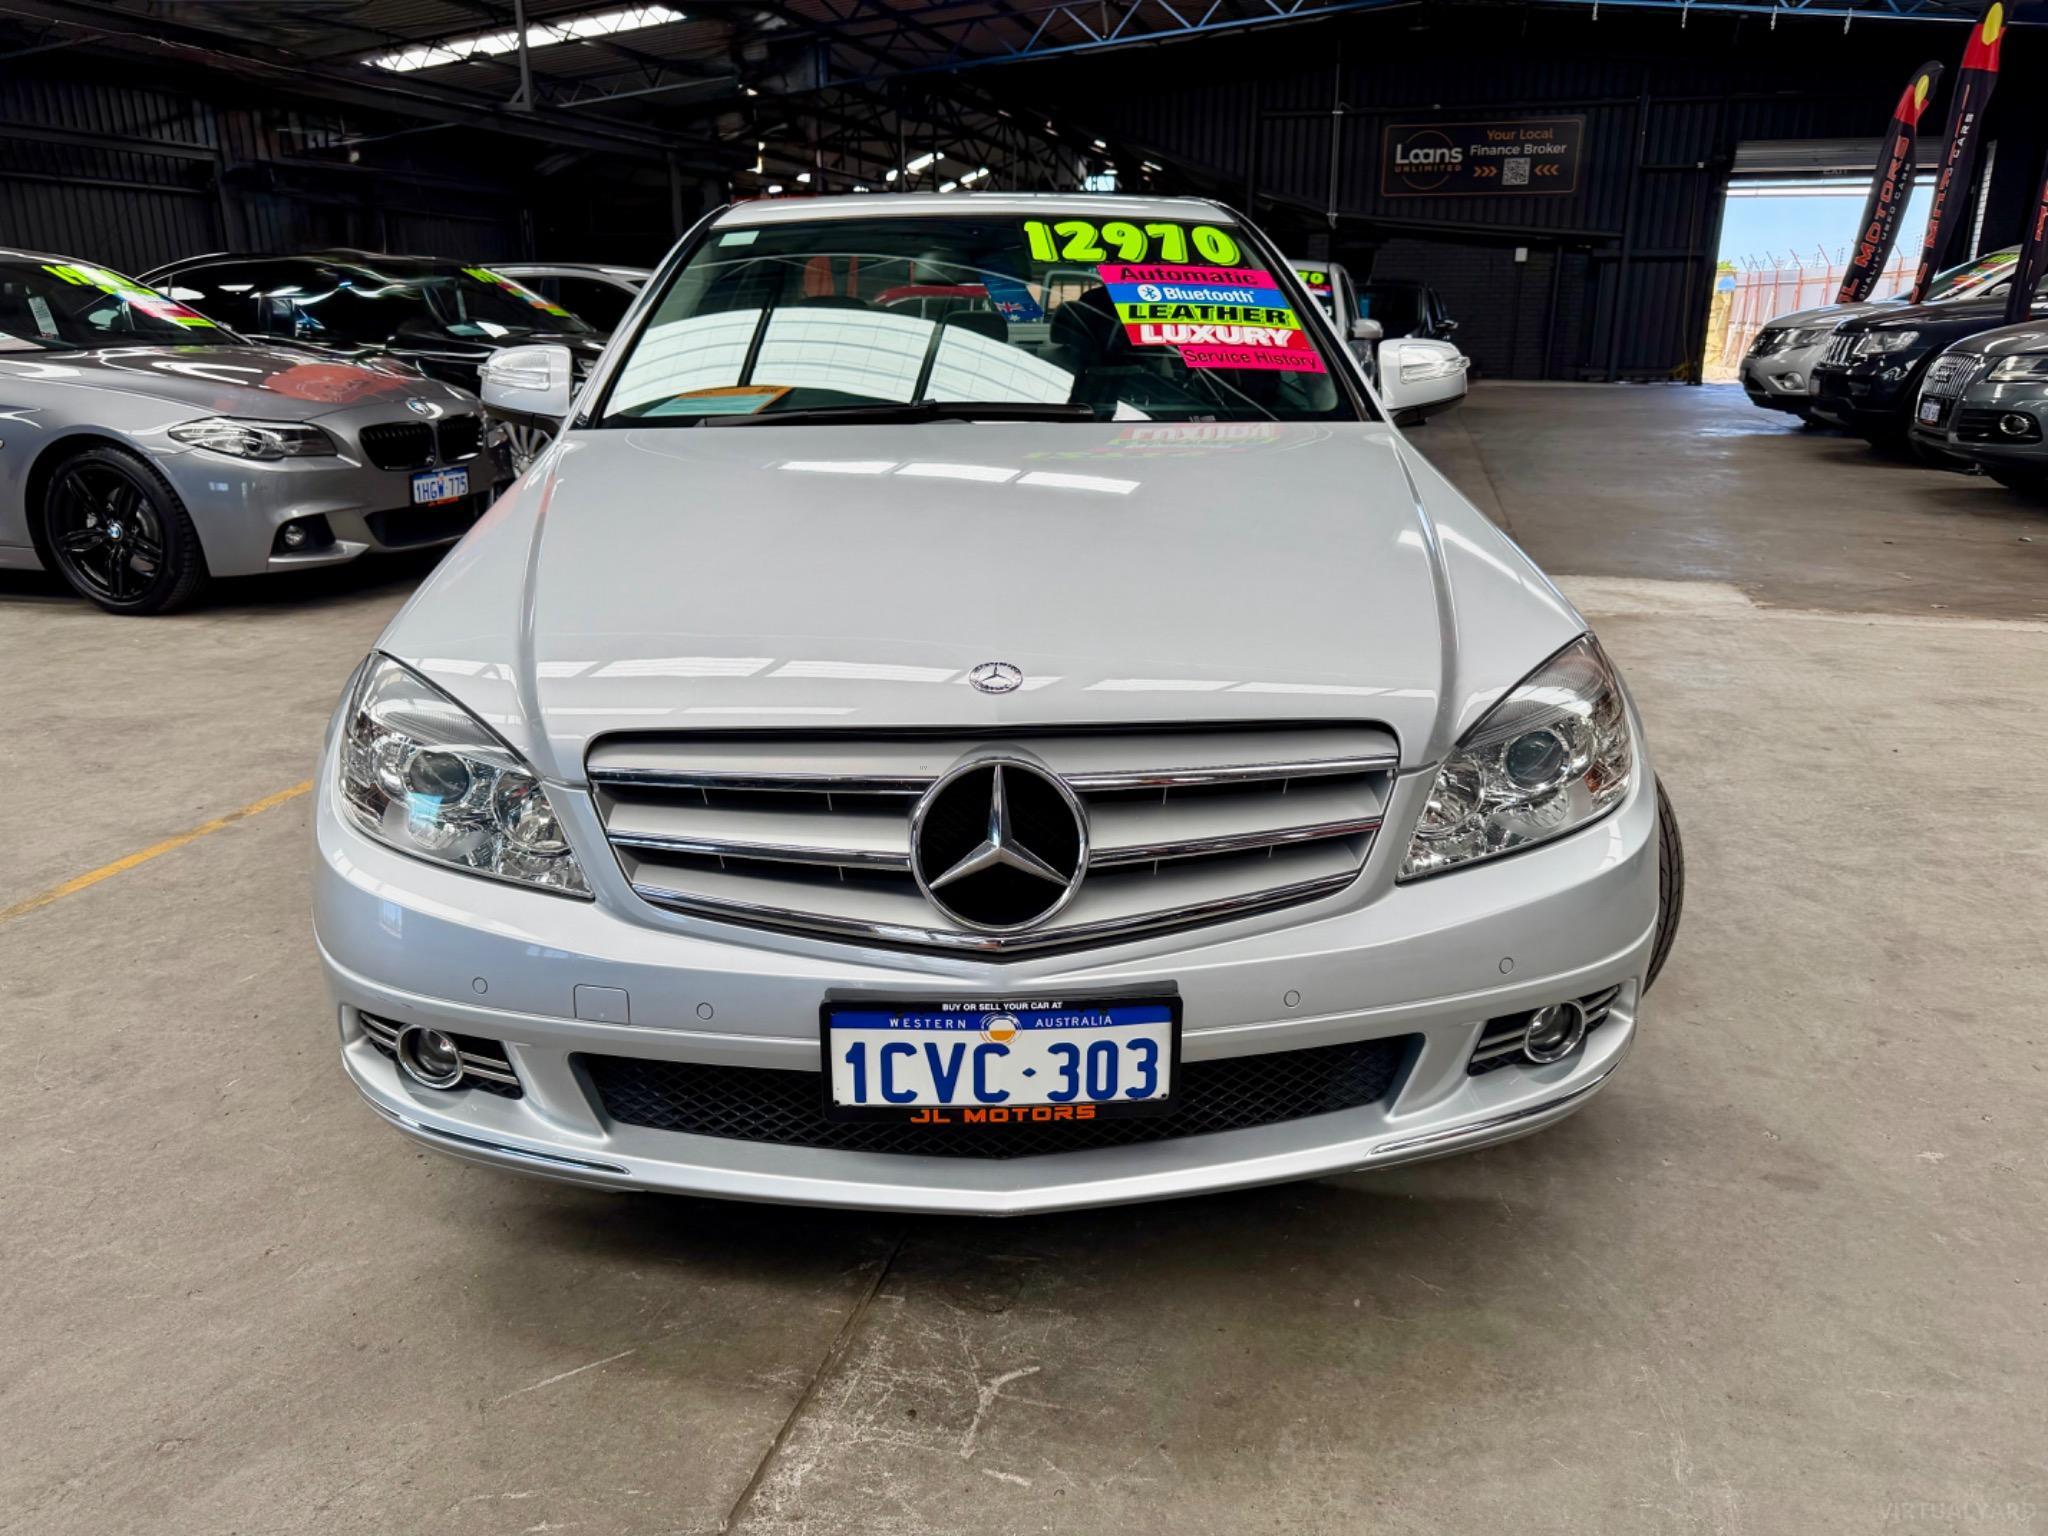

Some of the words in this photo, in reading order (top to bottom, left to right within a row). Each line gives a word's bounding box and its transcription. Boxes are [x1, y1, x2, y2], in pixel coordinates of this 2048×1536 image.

[1487, 130, 1516, 141] Your
[1520, 128, 1553, 140] Local
[1395, 144, 1463, 164] Loans
[1470, 144, 1520, 156] Finance
[1523, 143, 1567, 155] Broker
[1394, 164, 1462, 173] UNLIMITED
[1854, 135, 1910, 268] MOTORS
[1023, 220, 1241, 266] 12970
[1120, 267, 1258, 285] Automatic
[1163, 286, 1252, 303] Bluetooth
[1128, 304, 1290, 326] LEATHER
[1140, 324, 1293, 347] LUXURY
[1184, 349, 1250, 364] Service
[1253, 350, 1317, 368] History
[942, 1003, 962, 1011] BUY
[964, 1003, 977, 1011] OR
[979, 1002, 1002, 1011] SELL
[1004, 1002, 1029, 1011] YOUR
[1030, 1002, 1051, 1010] CAR
[1052, 1001, 1063, 1010] AT
[889, 1017, 966, 1029] WESTERN
[1034, 1016, 1113, 1028] AUSTRALIA
[911, 1106, 951, 1124] JL
[964, 1105, 1096, 1123] MOTORS
